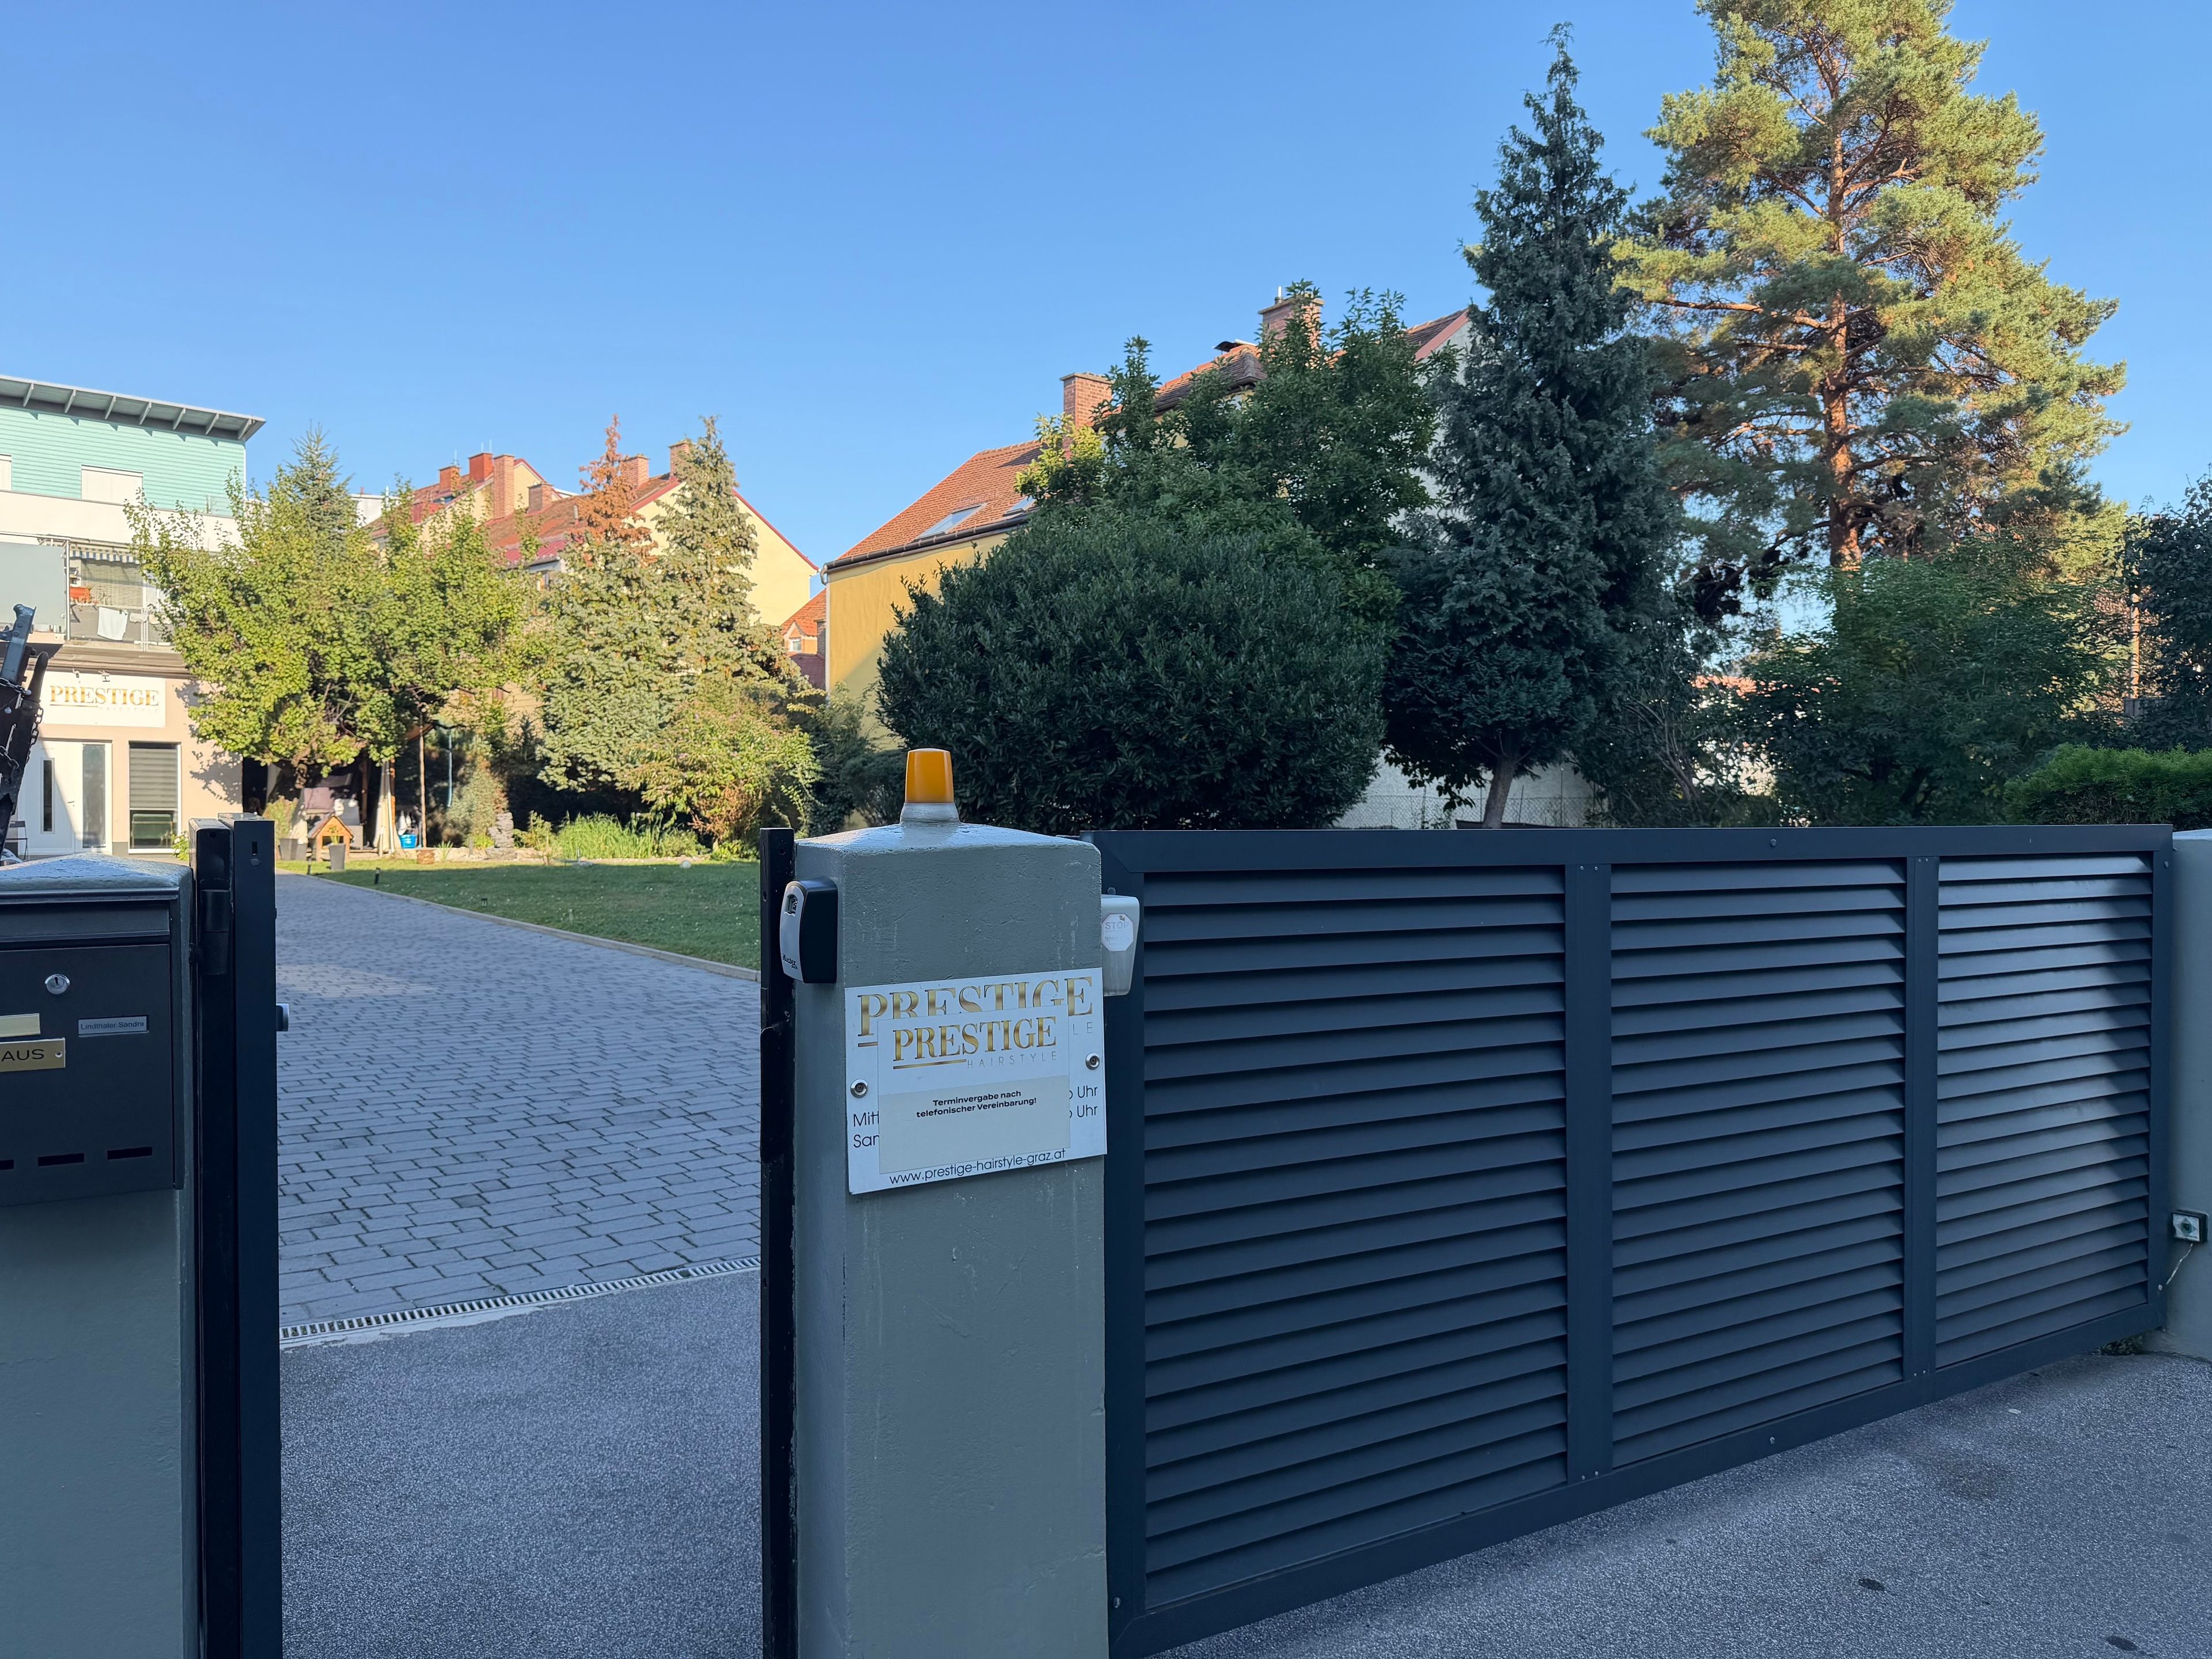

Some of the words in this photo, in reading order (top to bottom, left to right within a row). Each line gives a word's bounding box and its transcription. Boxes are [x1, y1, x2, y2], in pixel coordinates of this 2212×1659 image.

[50, 685, 158, 706] PRESTIGE
[1105, 921, 1129, 929] STOP
[857, 977, 1093, 1036] PRESTIGE
[81, 1021, 116, 1030] Lindthaler
[893, 1016, 1056, 1061] PRESTIGE
[2, 1049, 44, 1062] AUS
[967, 1051, 1056, 1069] HAIRSTYLE
[933, 1093, 999, 1107] Terminvergabe
[1001, 1090, 1021, 1099] nach
[1077, 1085, 1098, 1099] Uhr
[916, 1105, 976, 1118] telefonischer
[977, 1097, 1037, 1111] Vereinbarung!
[1077, 1104, 1098, 1118] Uhr
[889, 1148, 1066, 1184] www.prestige-hairstyle-graz.at
